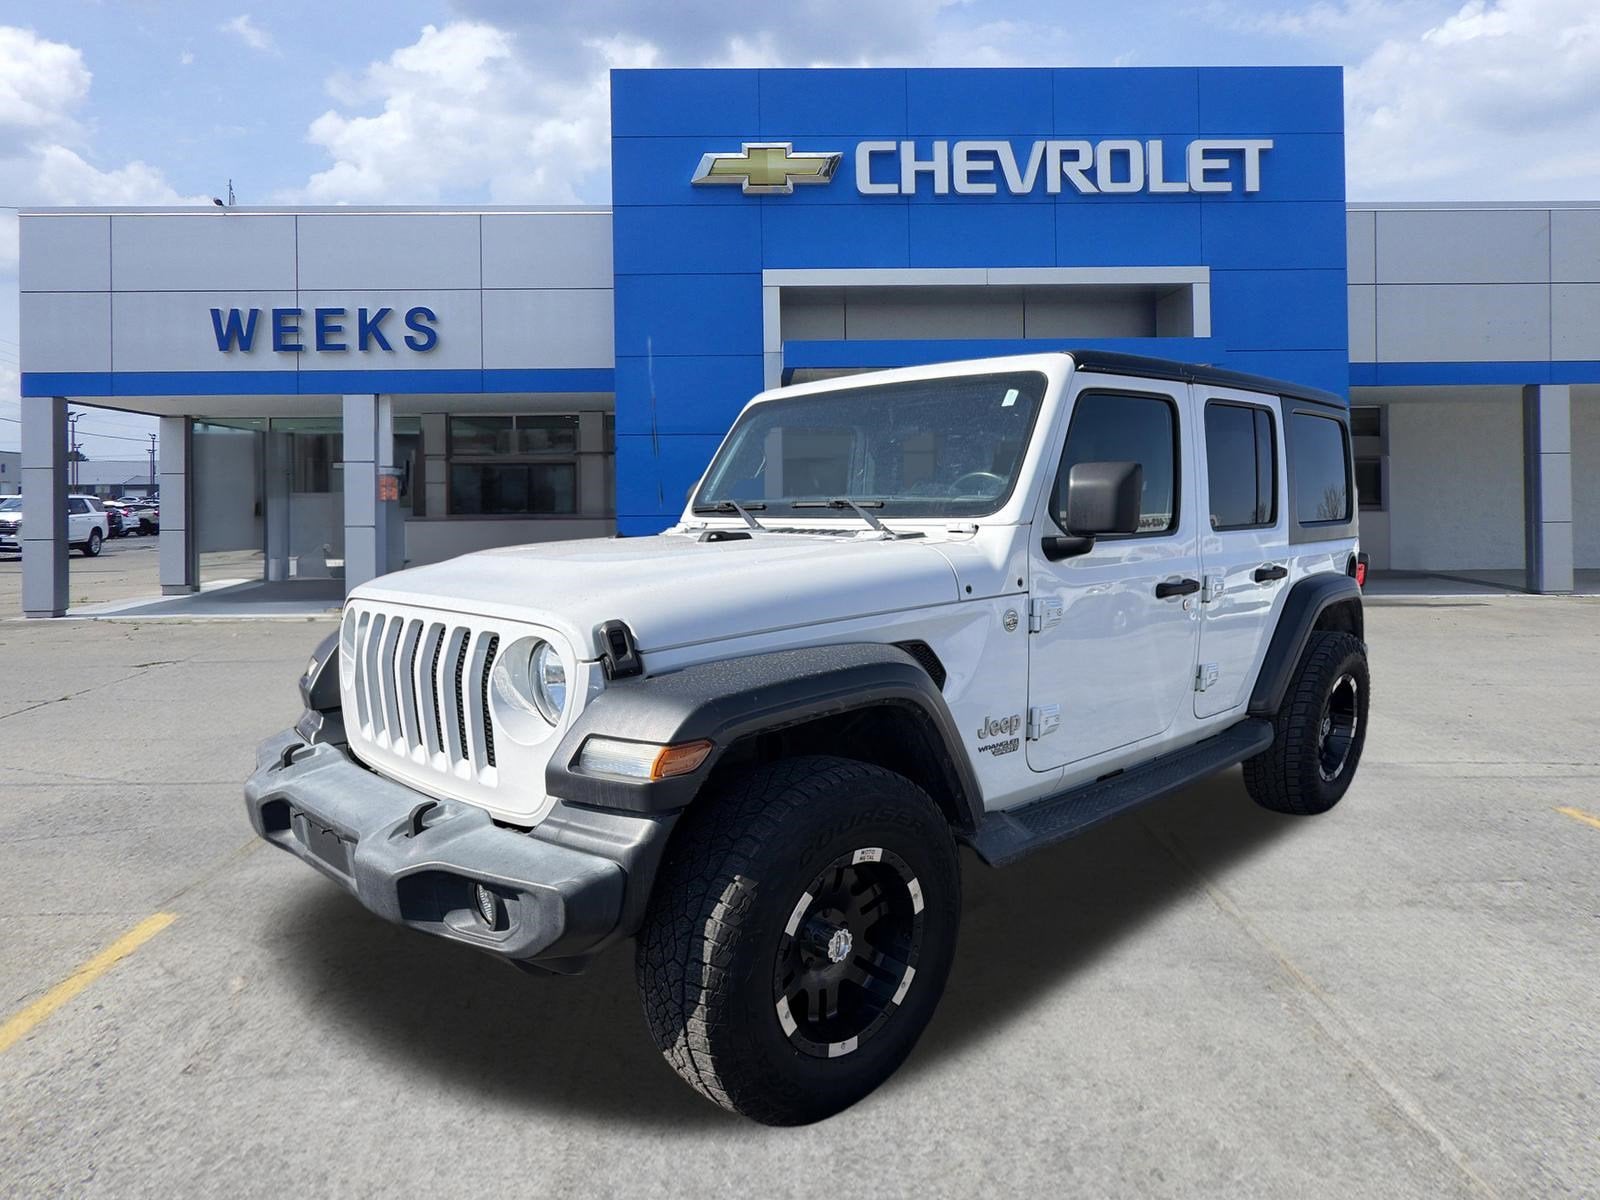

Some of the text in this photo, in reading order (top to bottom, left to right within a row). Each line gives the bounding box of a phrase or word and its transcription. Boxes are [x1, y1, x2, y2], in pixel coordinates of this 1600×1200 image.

[855, 139, 1274, 195] CHEVROLET
[210, 306, 439, 354] WEEKS
[977, 714, 1020, 739] Jeep
